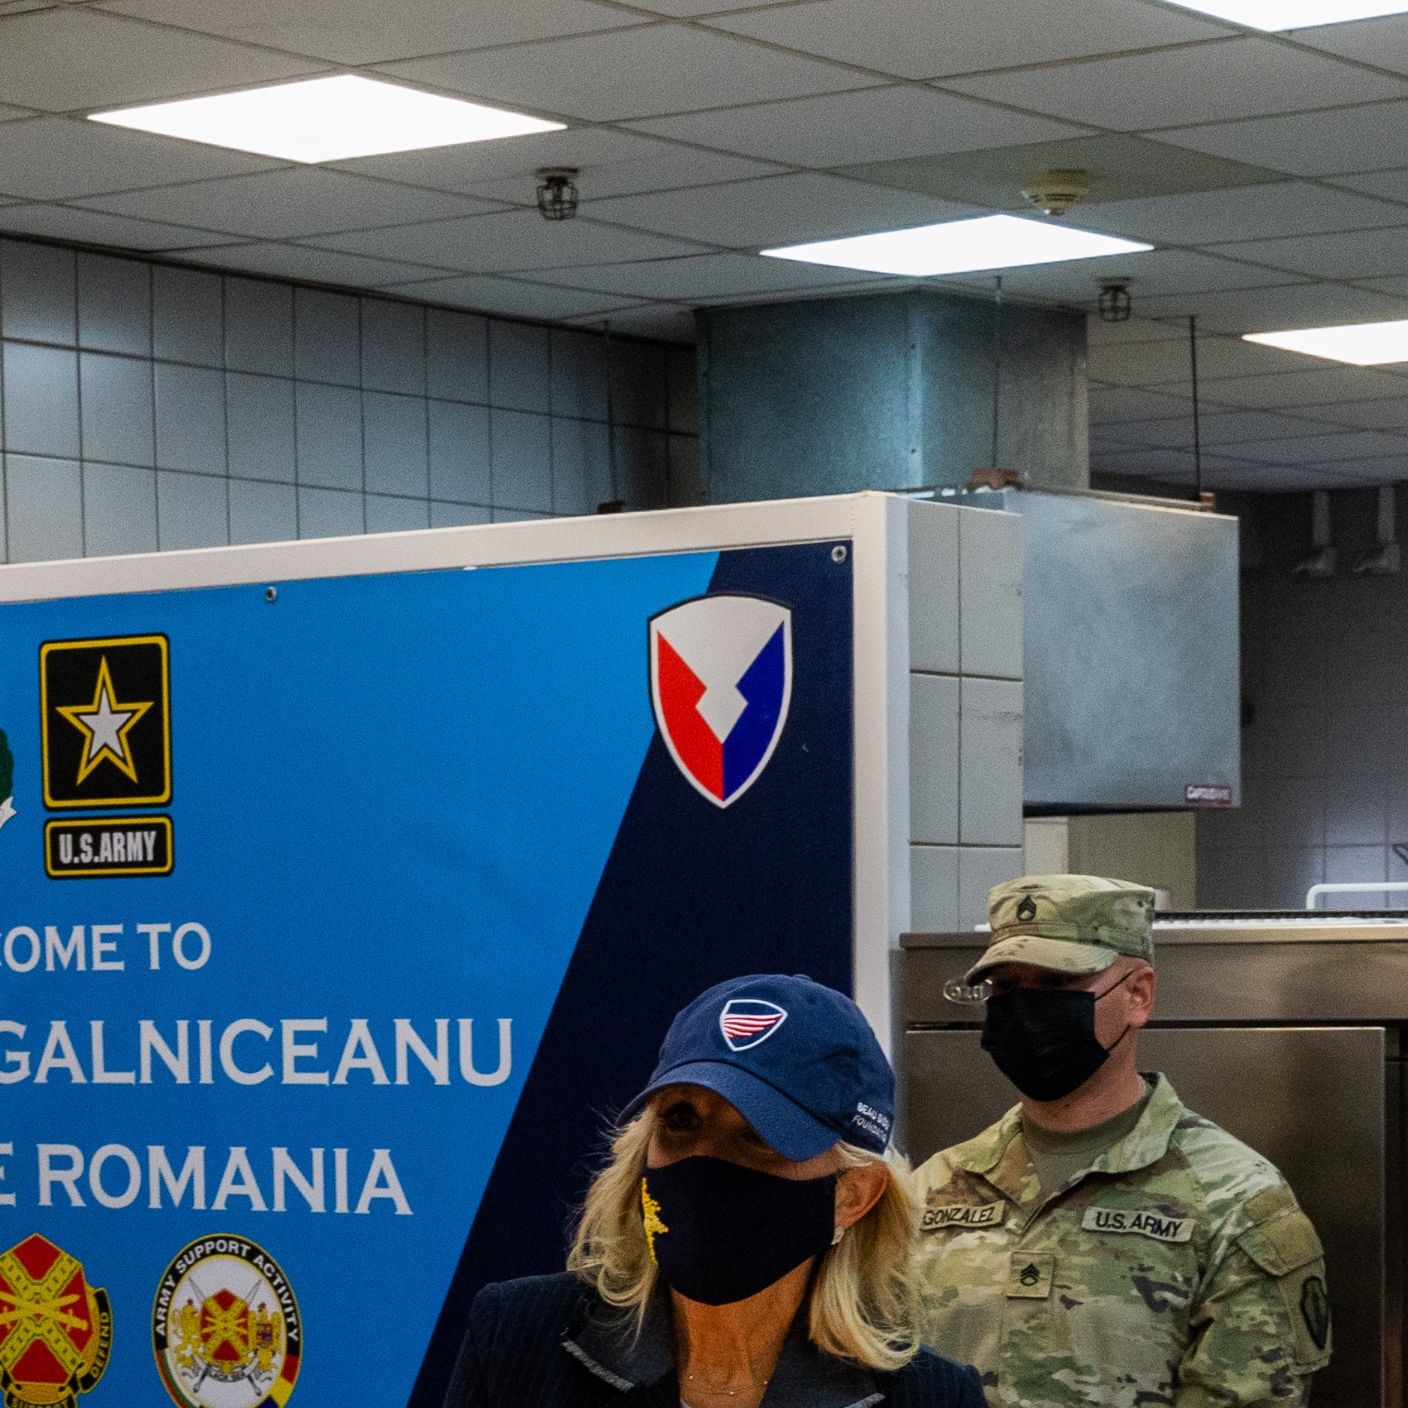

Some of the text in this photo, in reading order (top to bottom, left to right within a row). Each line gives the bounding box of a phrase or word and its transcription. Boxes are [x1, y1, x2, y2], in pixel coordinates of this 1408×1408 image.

[58, 830, 157, 864] U.S.ARMY
[136, 922, 212, 971] TO
[37, 1143, 414, 1216] ROMANIA
[922, 1205, 996, 1226] GONZALEZ
[1095, 1211, 1184, 1238] U.S. ARMY
[155, 1239, 300, 1342] ARMY SUPPORT ACTIVITY
[90, 1311, 111, 1378] DEFEND
